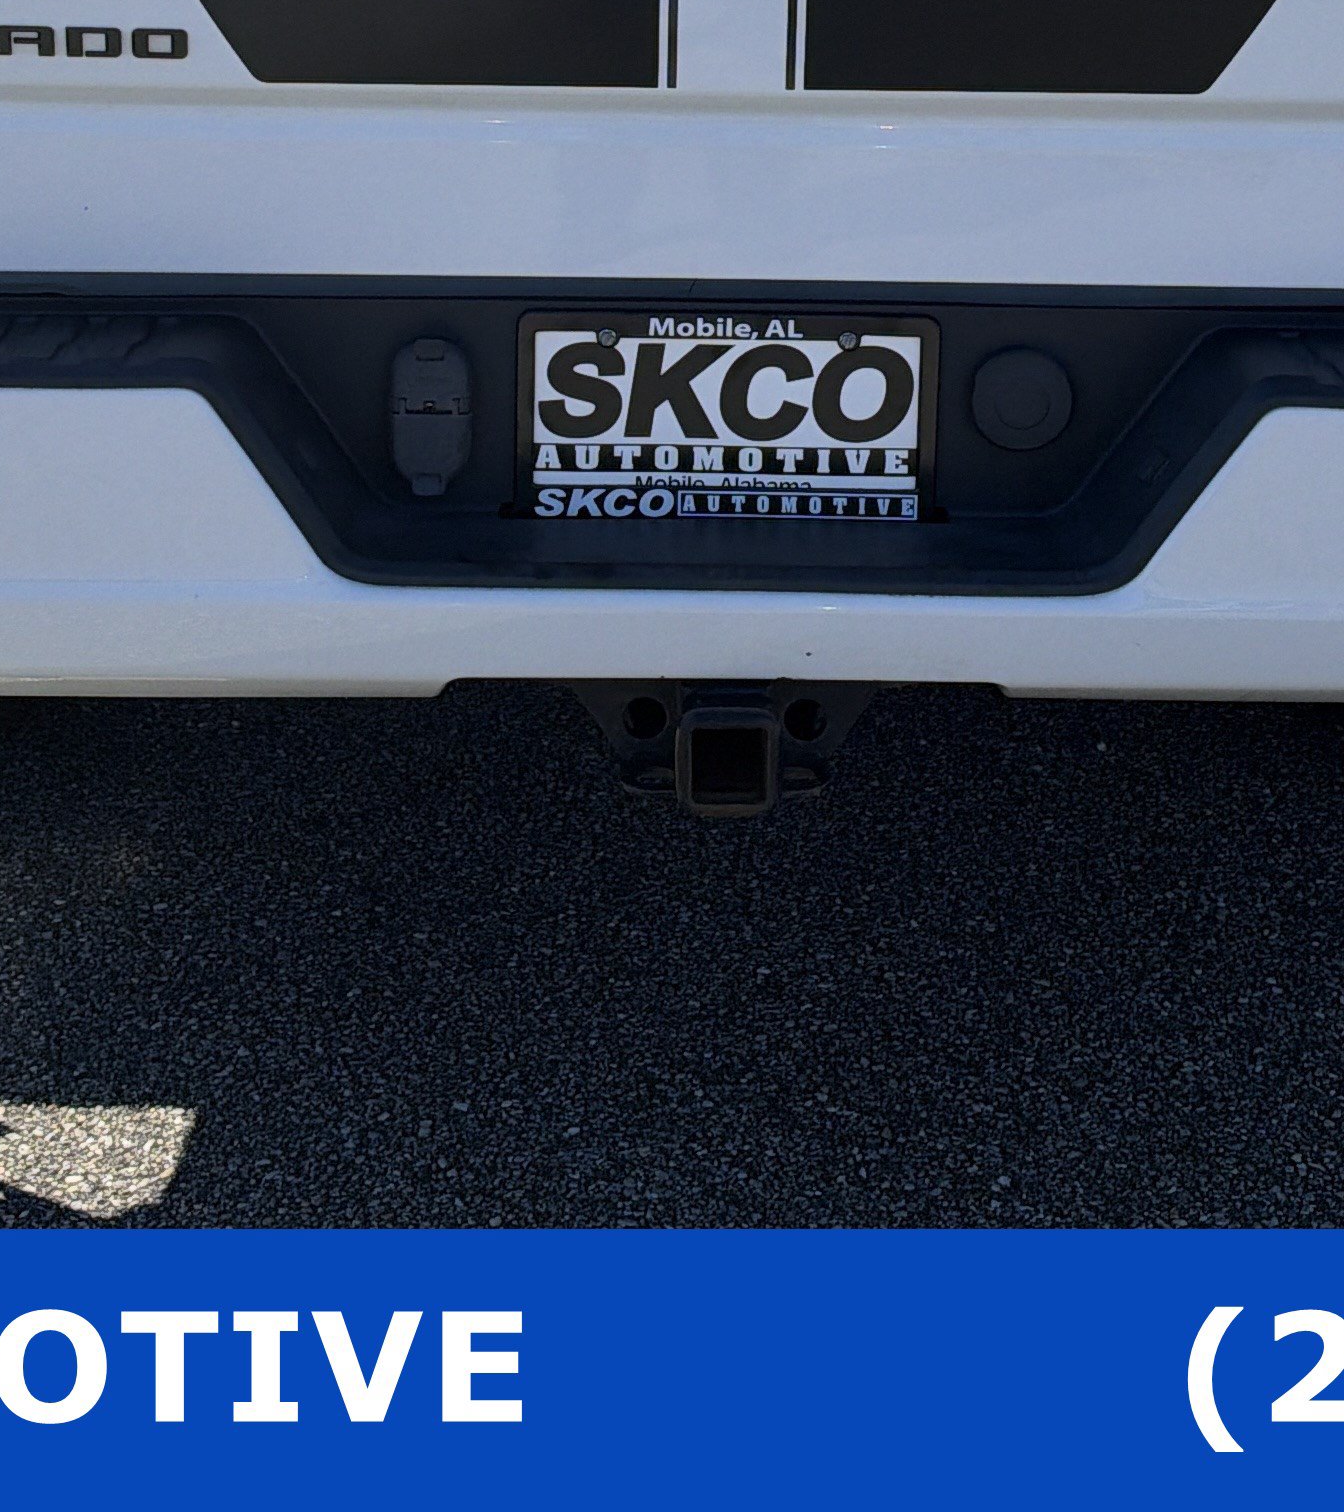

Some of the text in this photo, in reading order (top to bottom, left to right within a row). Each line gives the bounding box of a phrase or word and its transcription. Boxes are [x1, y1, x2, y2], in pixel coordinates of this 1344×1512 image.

[649, 317, 804, 339] Mobile, AL
[538, 342, 914, 443] SKCO
[535, 444, 909, 474] AUTOMOTIVE
[721, 476, 812, 488] Alabama
[534, 488, 915, 517] SKCO AUTOMOTIVE
